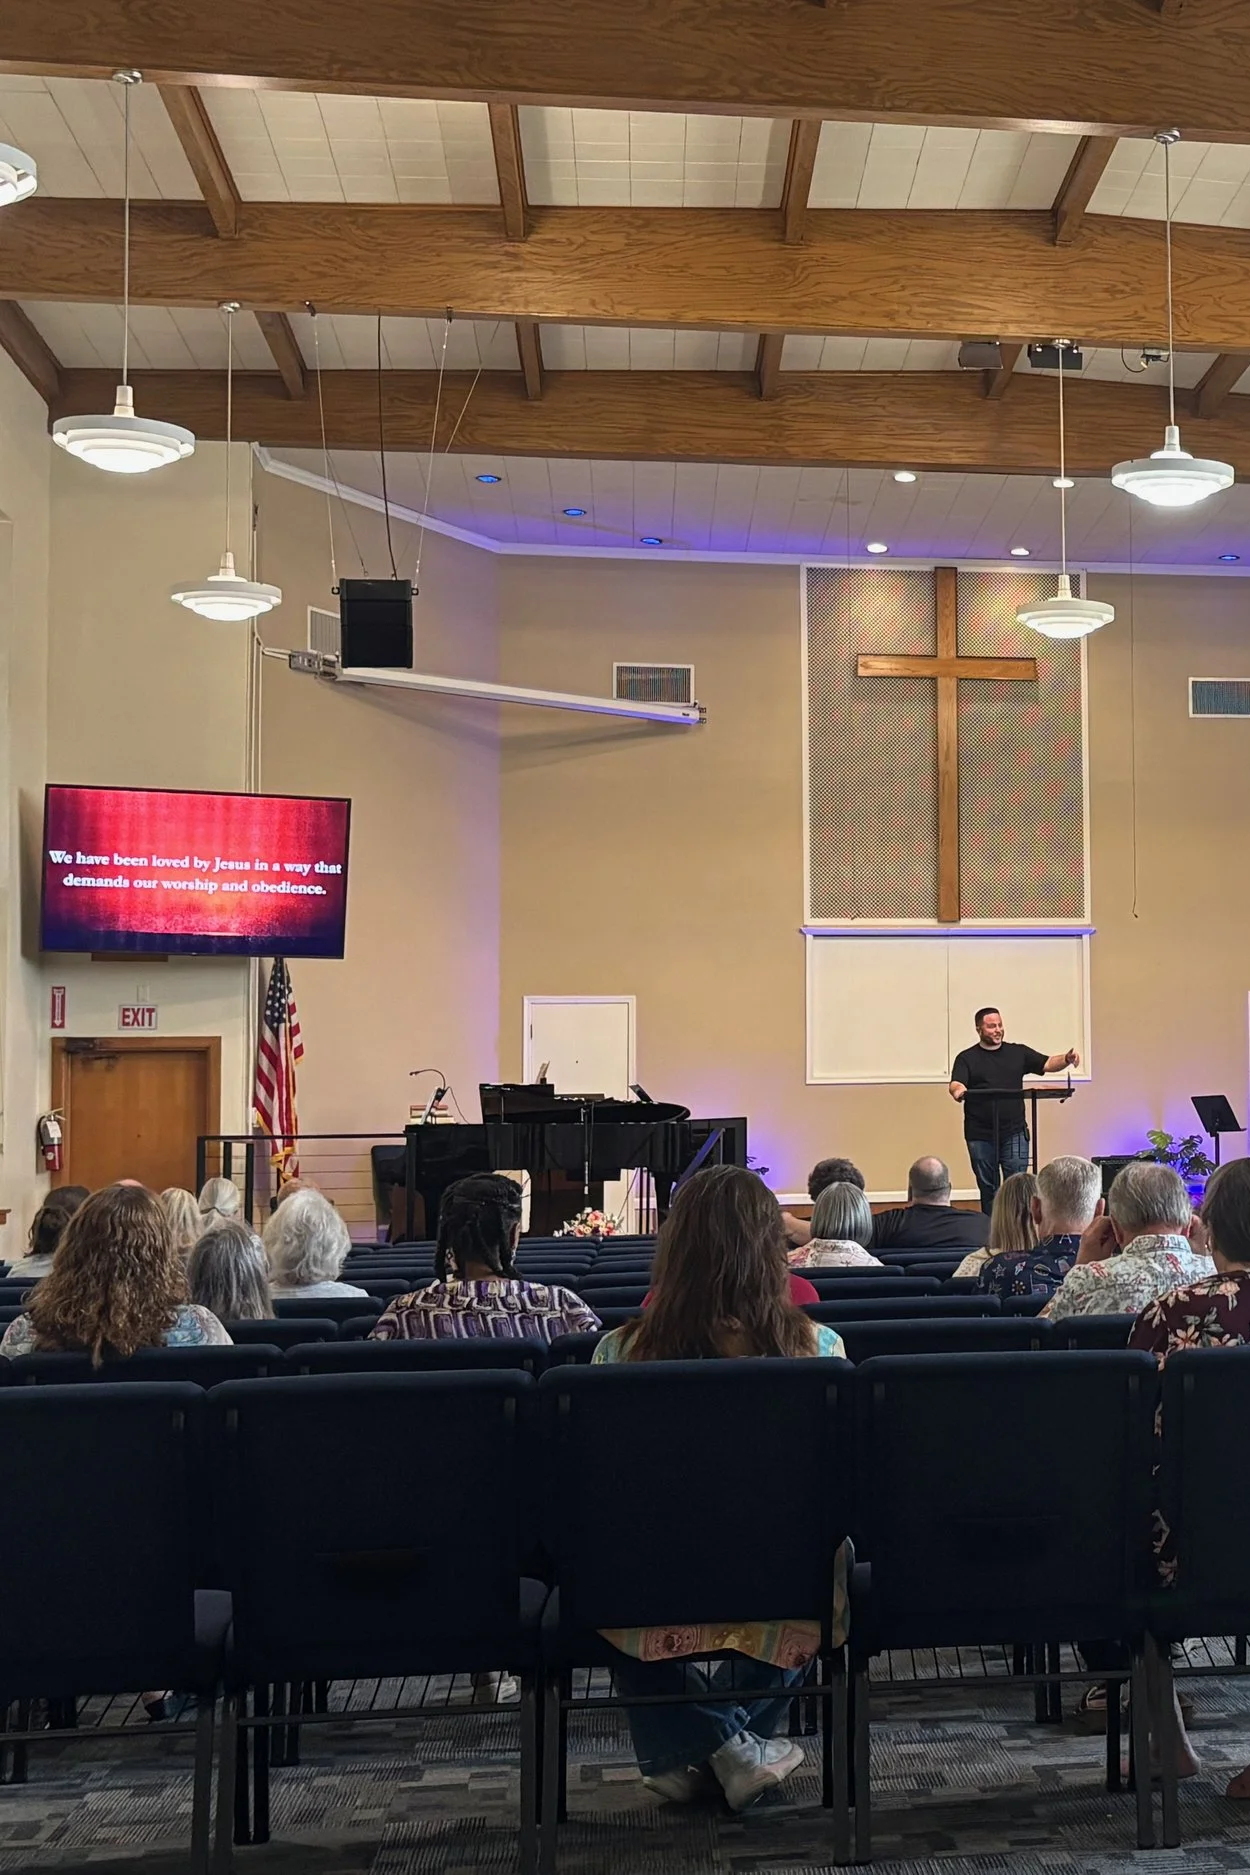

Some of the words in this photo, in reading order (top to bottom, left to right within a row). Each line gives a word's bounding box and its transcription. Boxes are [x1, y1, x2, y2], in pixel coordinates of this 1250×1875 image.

[49, 850, 73, 864] We
[75, 851, 110, 866] have
[113, 853, 148, 867] been
[151, 855, 190, 868] loved
[193, 856, 210, 873] by
[212, 856, 250, 873] Jesus
[254, 858, 269, 871] in
[271, 862, 281, 872] a
[283, 863, 312, 877] way
[314, 860, 342, 874] that
[62, 872, 130, 888] demands
[133, 879, 158, 889] our
[161, 878, 218, 895] worship
[221, 879, 249, 893] and
[251, 880, 327, 896] obedience.
[122, 1007, 156, 1027] EXIT
